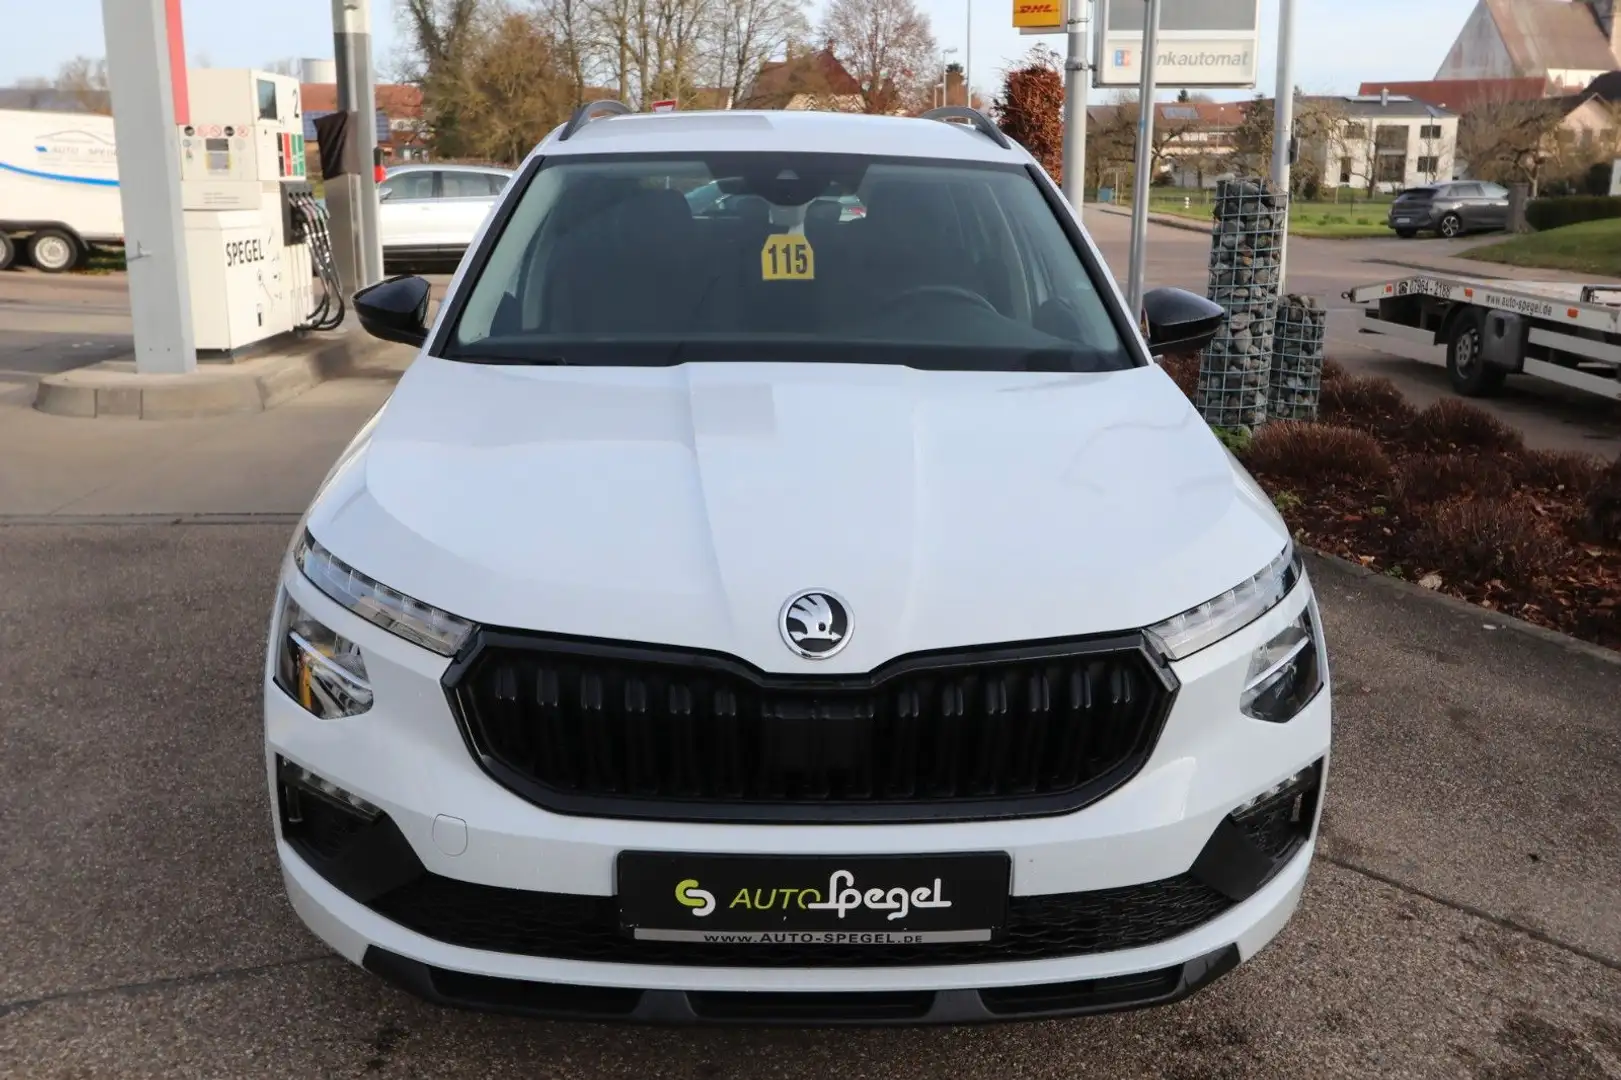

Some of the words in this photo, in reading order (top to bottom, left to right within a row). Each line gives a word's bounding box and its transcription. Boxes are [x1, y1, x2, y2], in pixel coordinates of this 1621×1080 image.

[1019, 4, 1053, 13] DHL
[292, 88, 300, 118] 2
[225, 239, 264, 267] SPEGEL
[767, 243, 808, 274] 115
[1486, 294, 1553, 316] www.auto-spegel.de
[729, 888, 821, 910] AUTO
